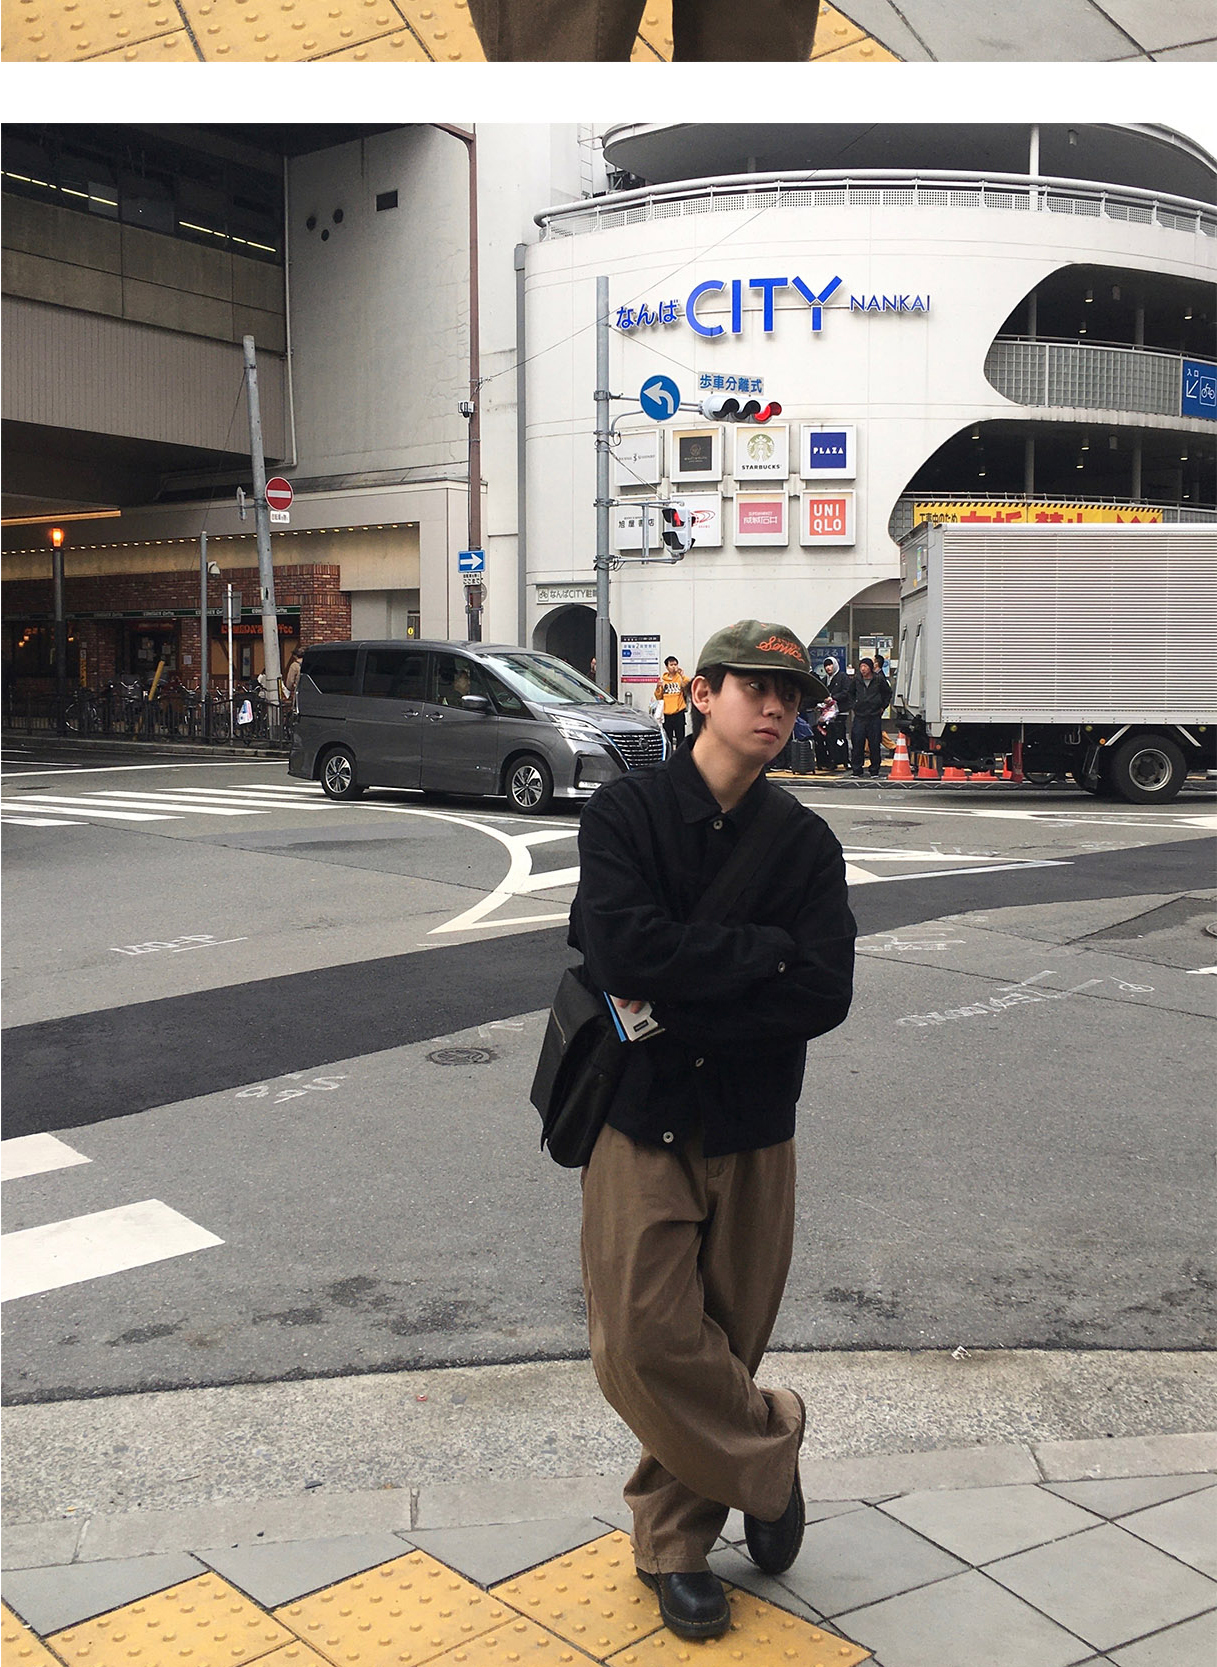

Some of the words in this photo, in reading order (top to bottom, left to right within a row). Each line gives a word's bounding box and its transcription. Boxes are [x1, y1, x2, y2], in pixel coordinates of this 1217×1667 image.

[616, 299, 680, 330] なんば
[685, 275, 843, 338] CITY
[849, 294, 931, 313] NANKAI
[699, 373, 763, 394] 歩車分離式
[813, 503, 840, 517] UNI
[813, 519, 842, 534] QLO
